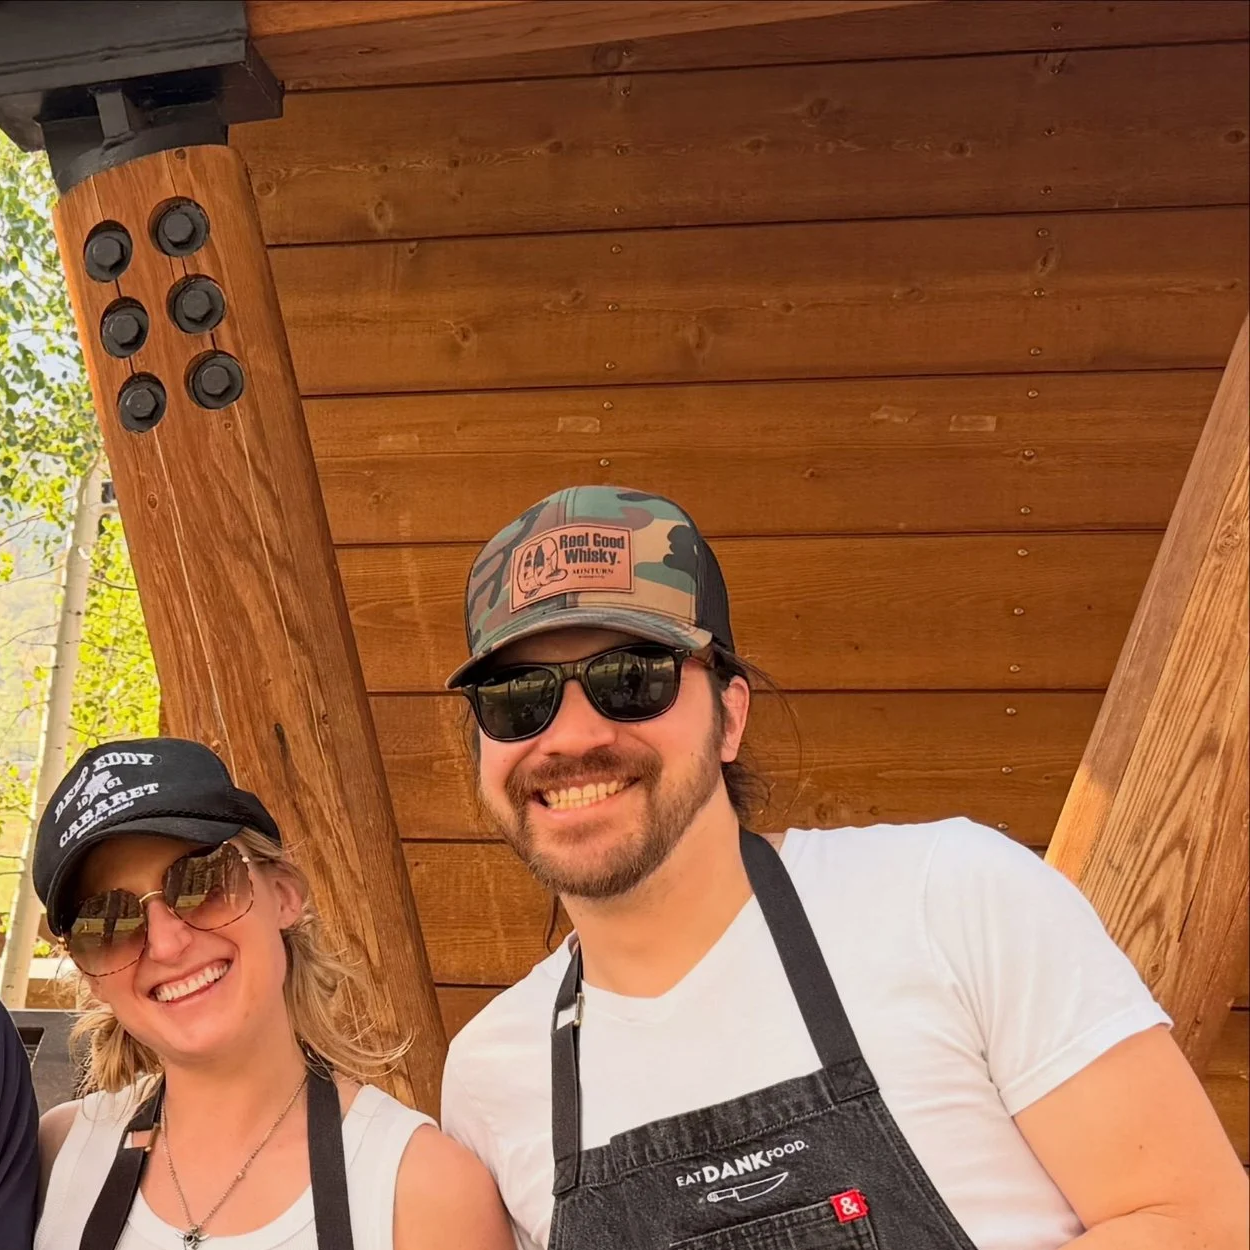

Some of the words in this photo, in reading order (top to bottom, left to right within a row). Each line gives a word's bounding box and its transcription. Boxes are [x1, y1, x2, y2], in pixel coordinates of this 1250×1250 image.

[593, 532, 625, 550] Good
[93, 751, 155, 773] EDDY
[59, 782, 159, 848] CABARET
[675, 1170, 703, 1188] EAT
[701, 1150, 771, 1184] DANK
[838, 1196, 861, 1216] &
